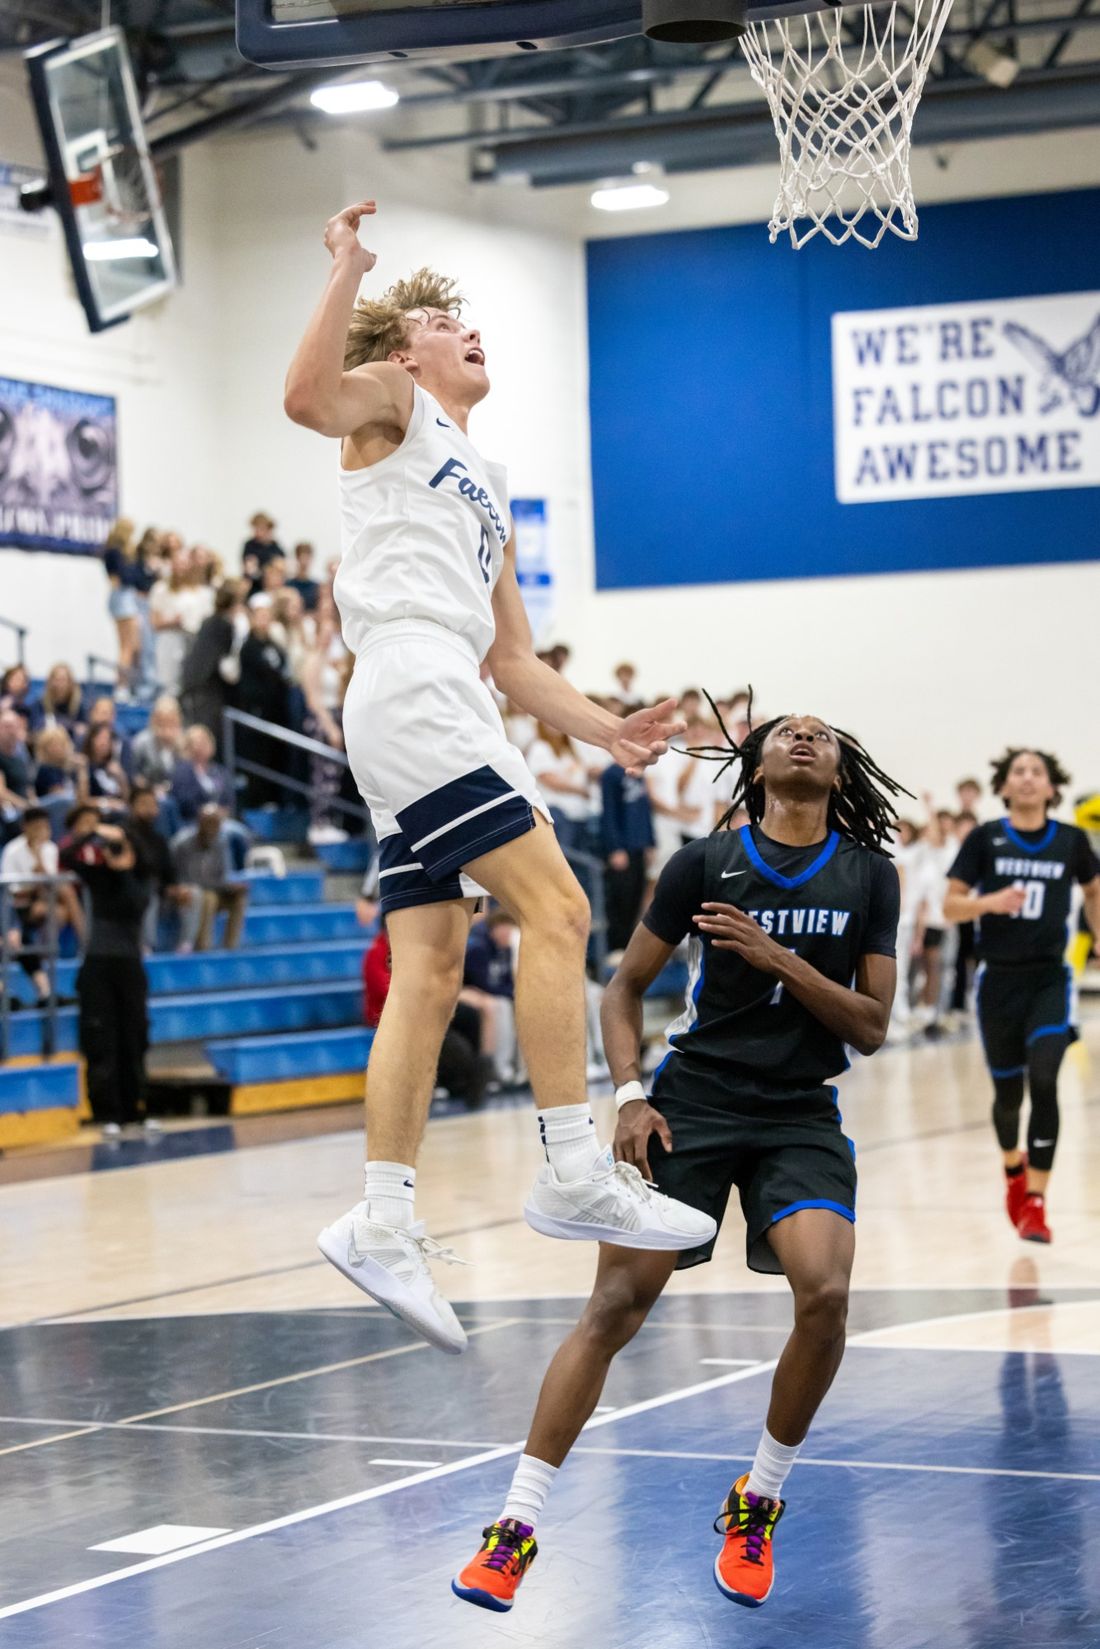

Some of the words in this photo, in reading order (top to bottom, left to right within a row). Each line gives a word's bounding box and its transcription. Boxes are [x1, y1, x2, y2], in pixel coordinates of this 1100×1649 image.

[852, 318, 994, 365] WE'RE
[853, 375, 1024, 426] FALCON
[855, 431, 1081, 485] AWESOME
[748, 909, 850, 936] STVIEW
